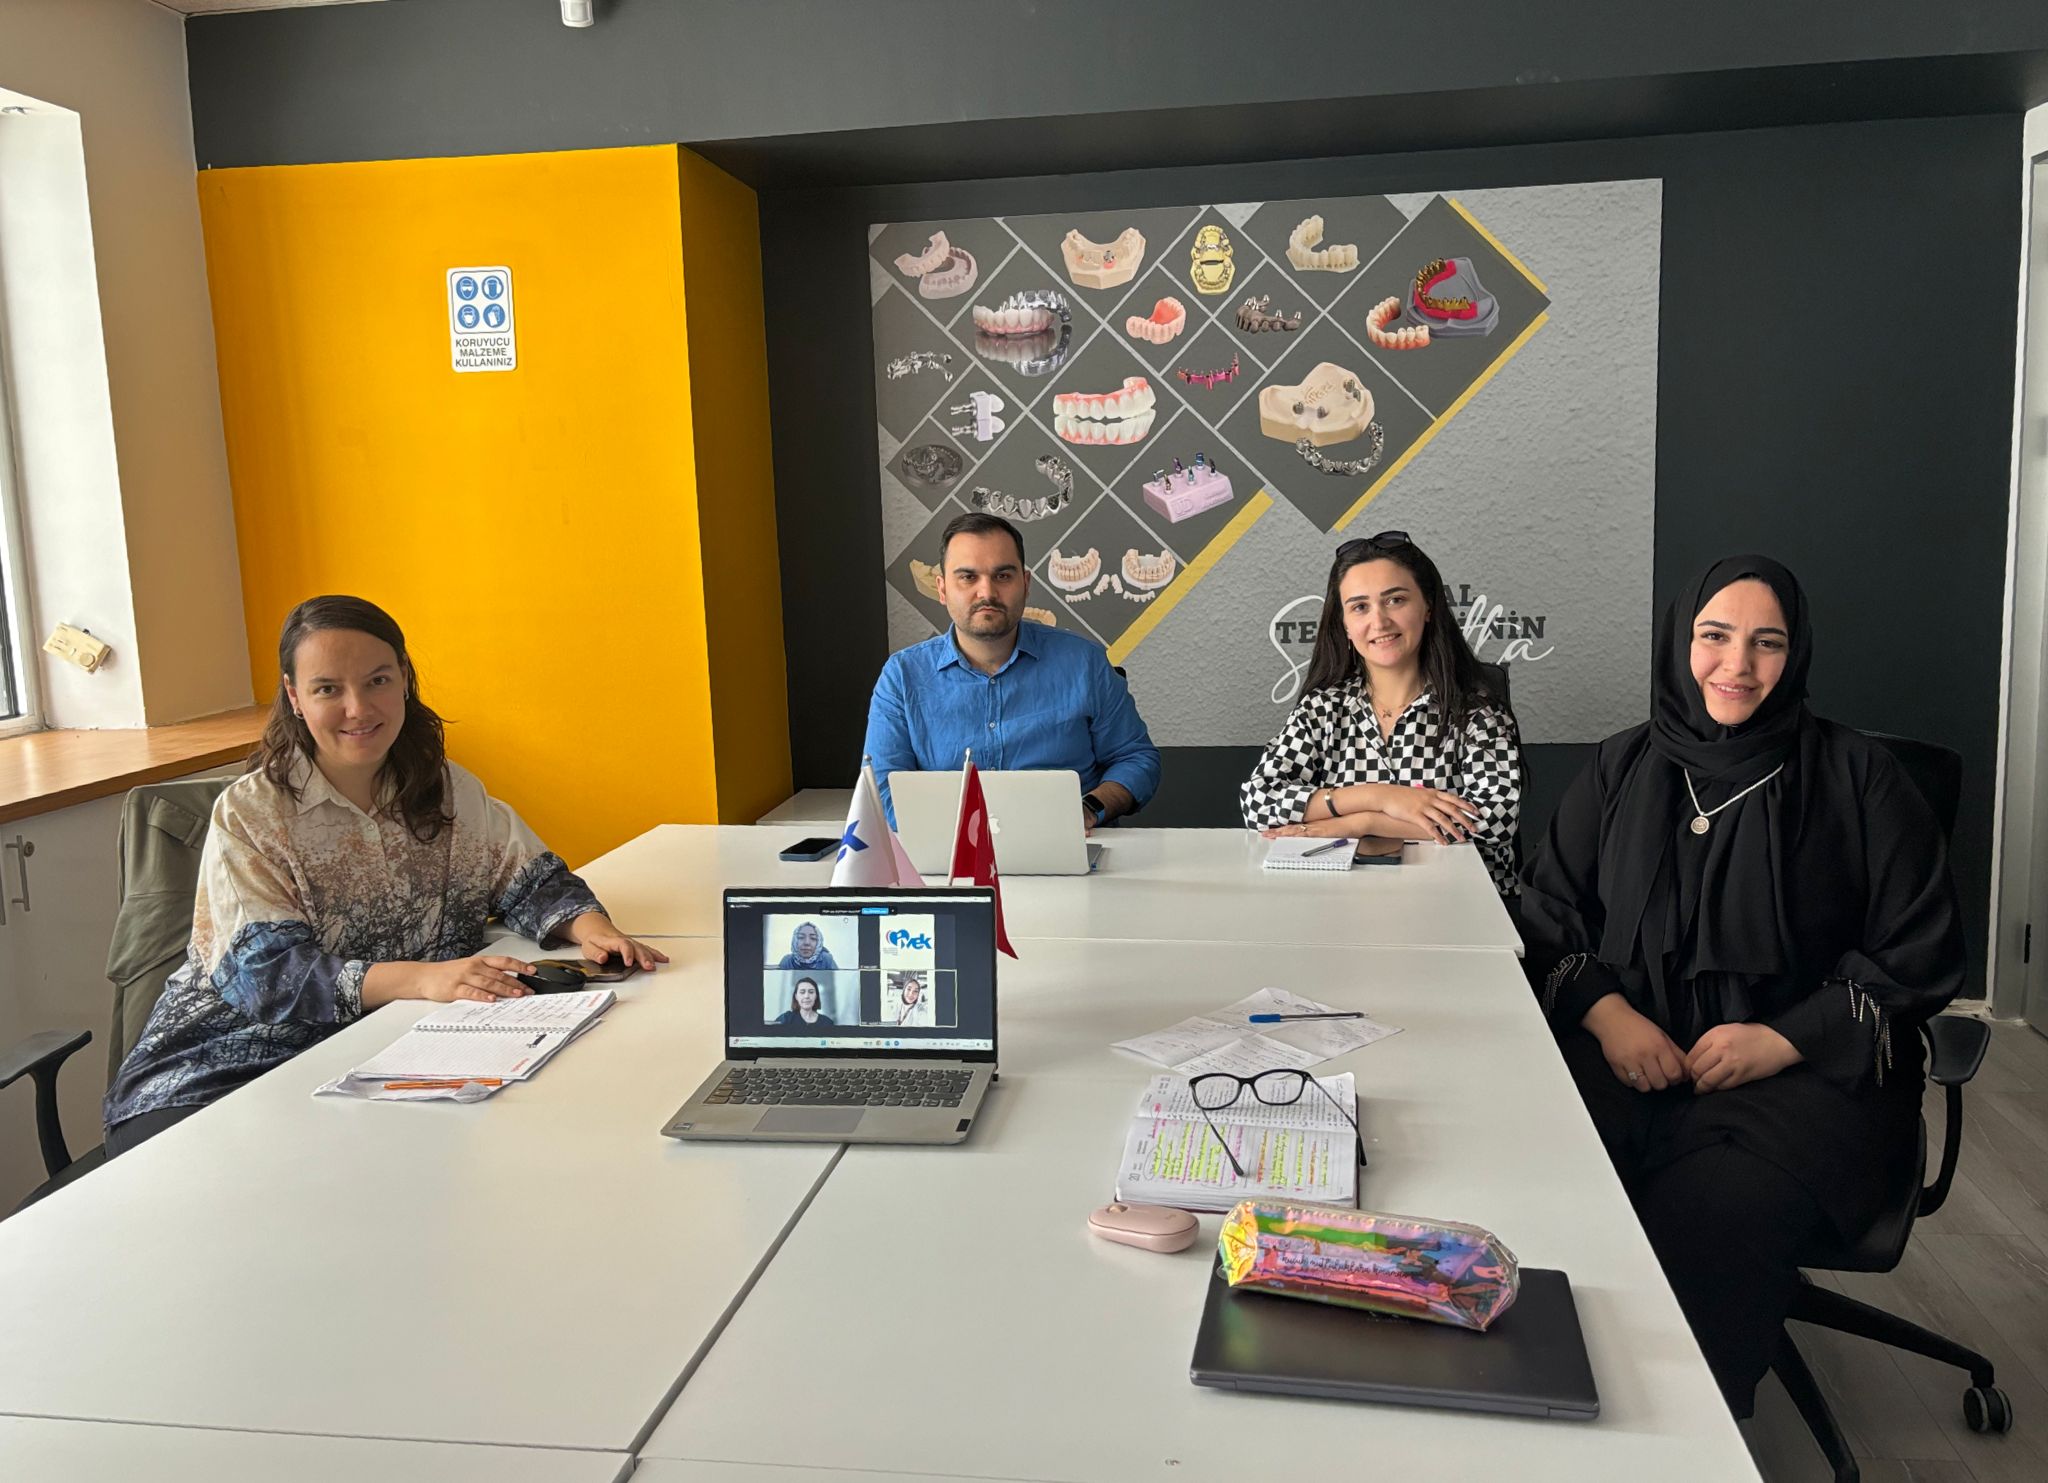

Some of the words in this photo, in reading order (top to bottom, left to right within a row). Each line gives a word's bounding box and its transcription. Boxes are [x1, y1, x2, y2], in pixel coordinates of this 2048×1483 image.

[455, 337, 510, 347] KORUYUCU
[460, 347, 507, 357] MALZEME
[455, 357, 512, 367] KULLANINIZ
